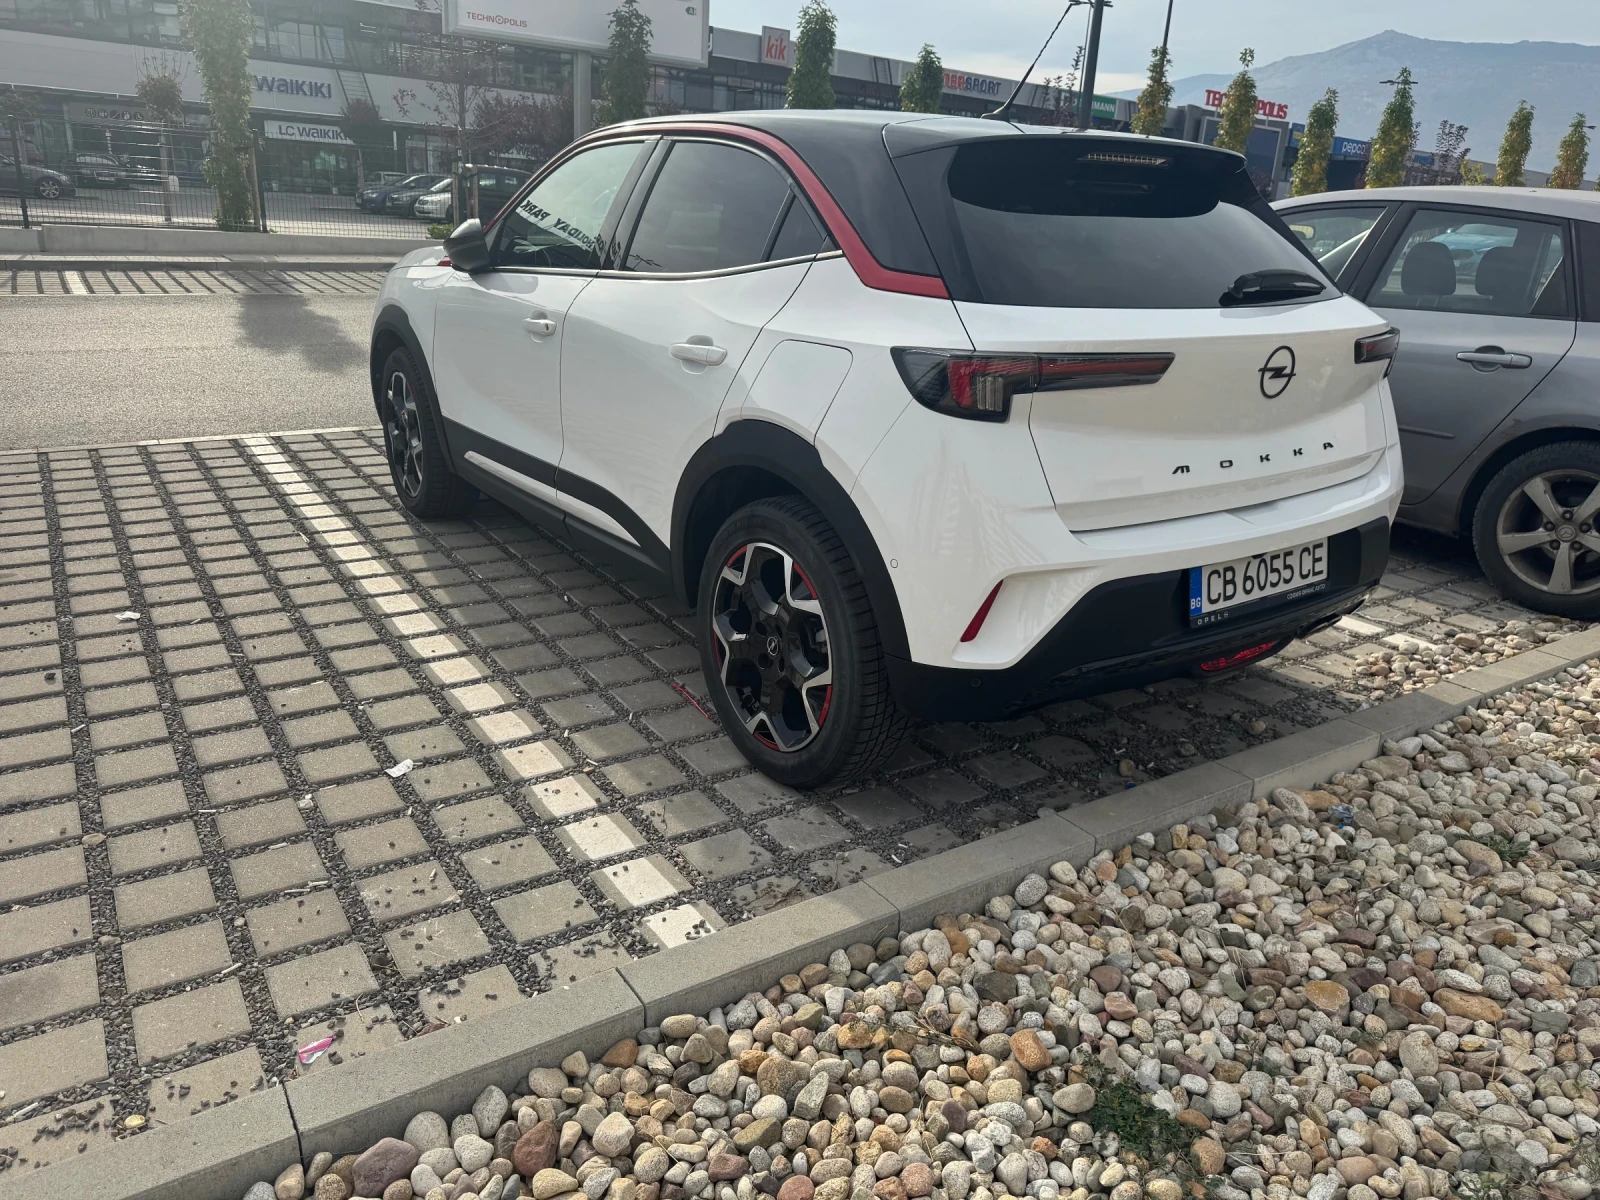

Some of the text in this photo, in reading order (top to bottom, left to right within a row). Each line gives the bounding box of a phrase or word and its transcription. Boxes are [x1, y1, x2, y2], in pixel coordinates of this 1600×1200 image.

[466, 11, 528, 28] TECHNOPOLIS
[765, 32, 787, 61] kik
[943, 72, 1002, 96] TERSPORT
[278, 124, 296, 137] LC
[1341, 141, 1366, 155] pepco
[1172, 442, 1334, 475] MOKKA
[1207, 542, 1324, 605] CB 6055 CE
[1190, 597, 1201, 610] BG
[1197, 613, 1222, 625] OPEL
